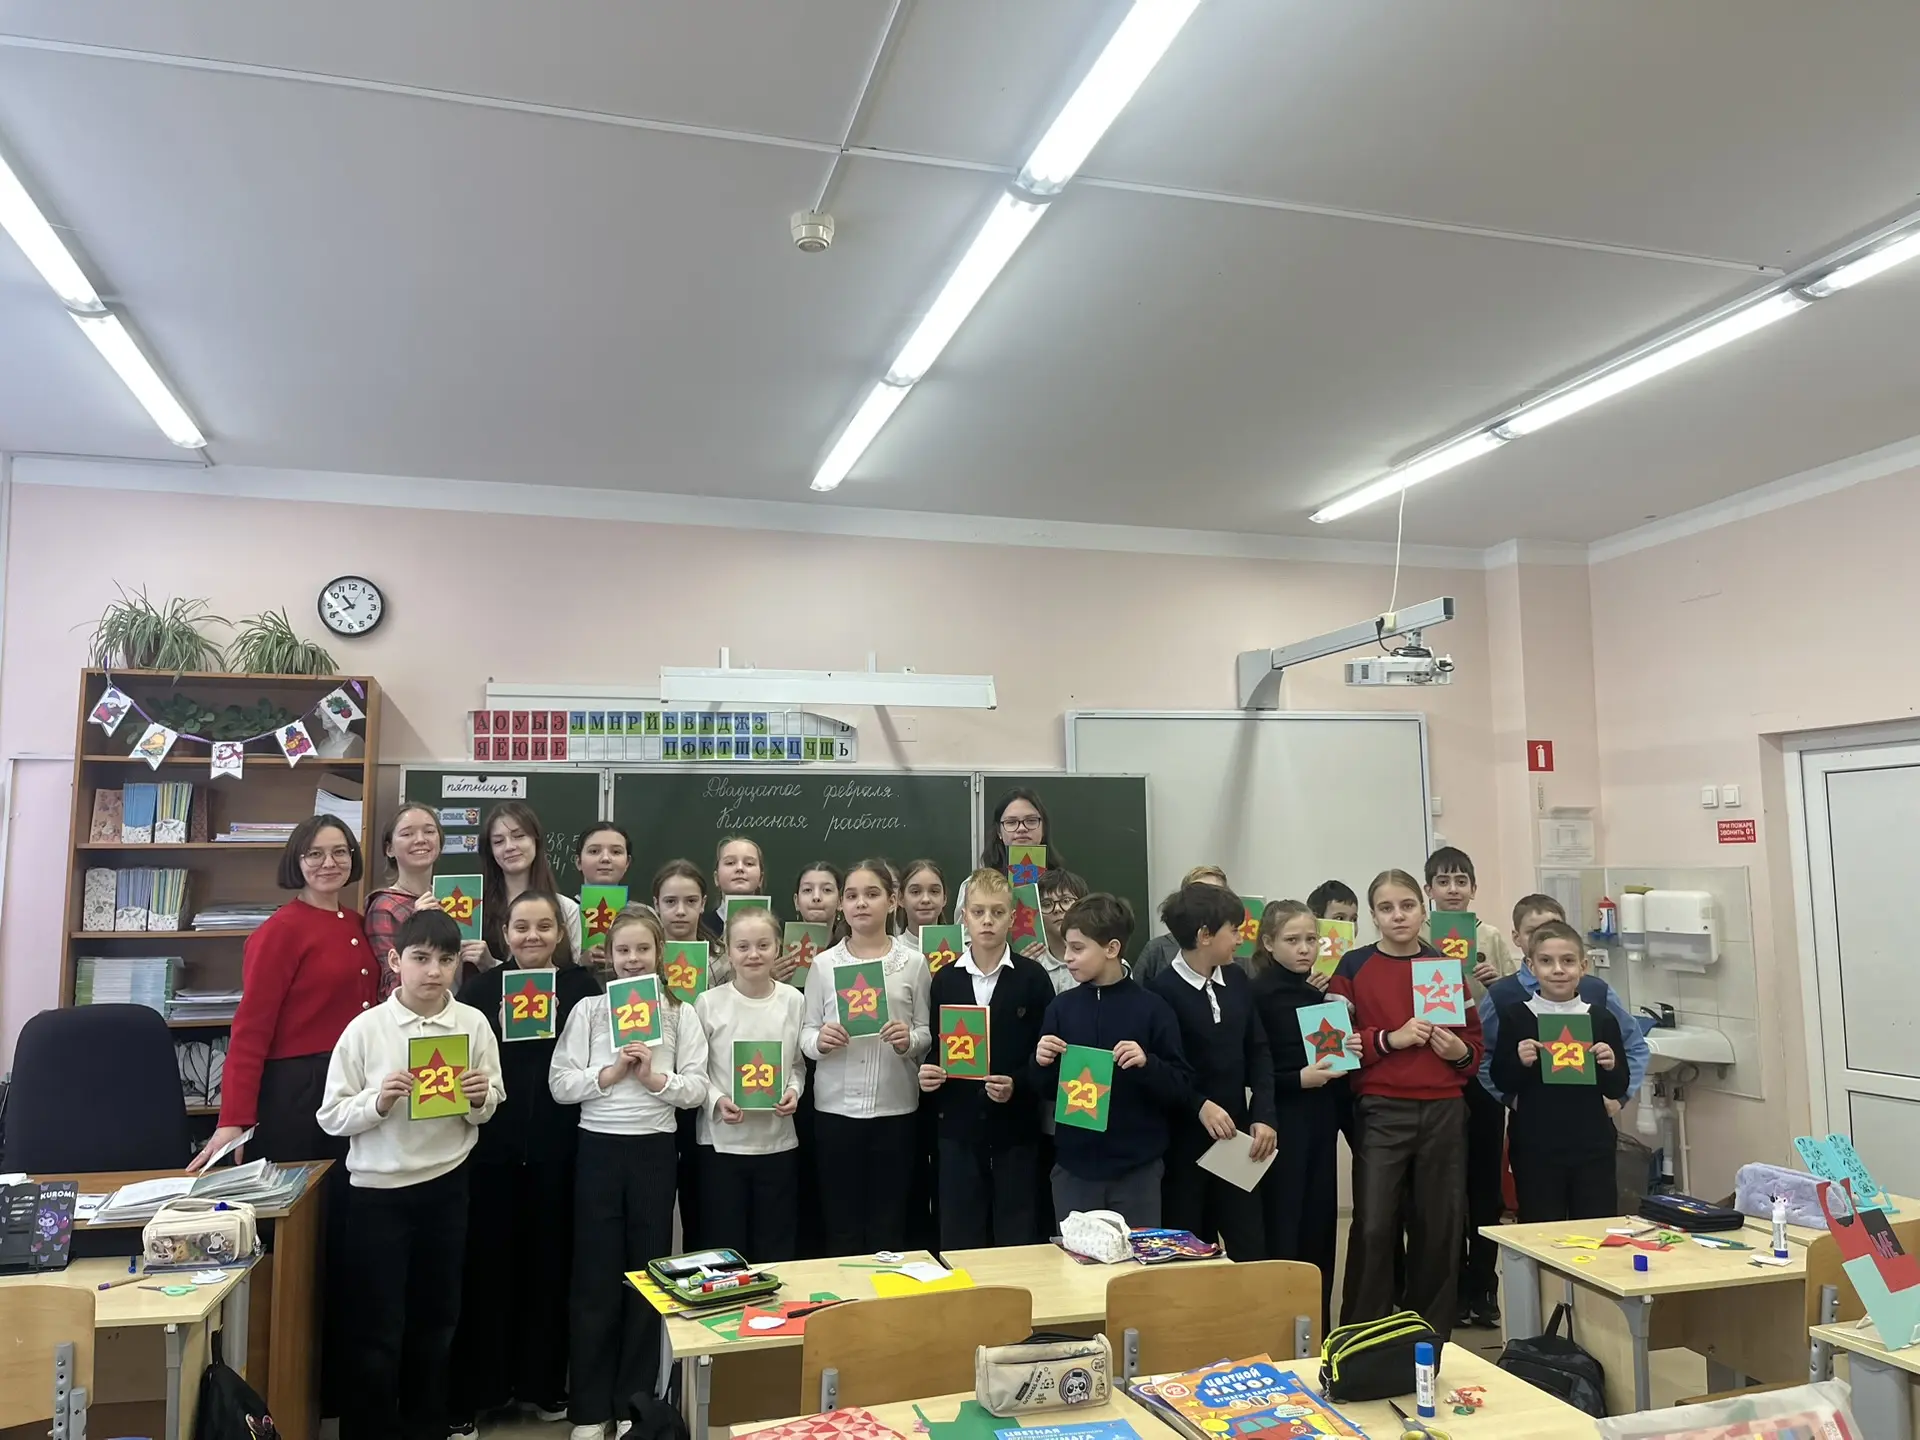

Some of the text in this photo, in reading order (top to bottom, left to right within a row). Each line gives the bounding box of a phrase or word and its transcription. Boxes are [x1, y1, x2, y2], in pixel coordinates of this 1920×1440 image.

[702, 776, 802, 809] Двадцатое
[716, 807, 808, 829] Классная
[1012, 864, 1038, 884] 23
[441, 896, 473, 918] 23
[584, 907, 616, 928] 23
[1319, 937, 1348, 956] 23
[1442, 939, 1469, 959] 23
[667, 964, 697, 989] 23
[846, 988, 879, 1013] 23
[1426, 982, 1456, 1003] 23
[512, 994, 549, 1020] 23
[616, 1002, 650, 1031] 23
[947, 1036, 975, 1060] 23
[1313, 1030, 1343, 1052] 23
[1551, 1042, 1586, 1067] 23
[418, 1066, 456, 1096] 23
[741, 1063, 775, 1088] 23
[1067, 1079, 1099, 1109] 23
[40, 1190, 75, 1200] KUROMI
[1203, 1376, 1275, 1396] НАБОР
[1205, 1366, 1261, 1388] ЦВЕТНОЙ
[1003, 1428, 1061, 1438] ЦВЕТНАЯ
